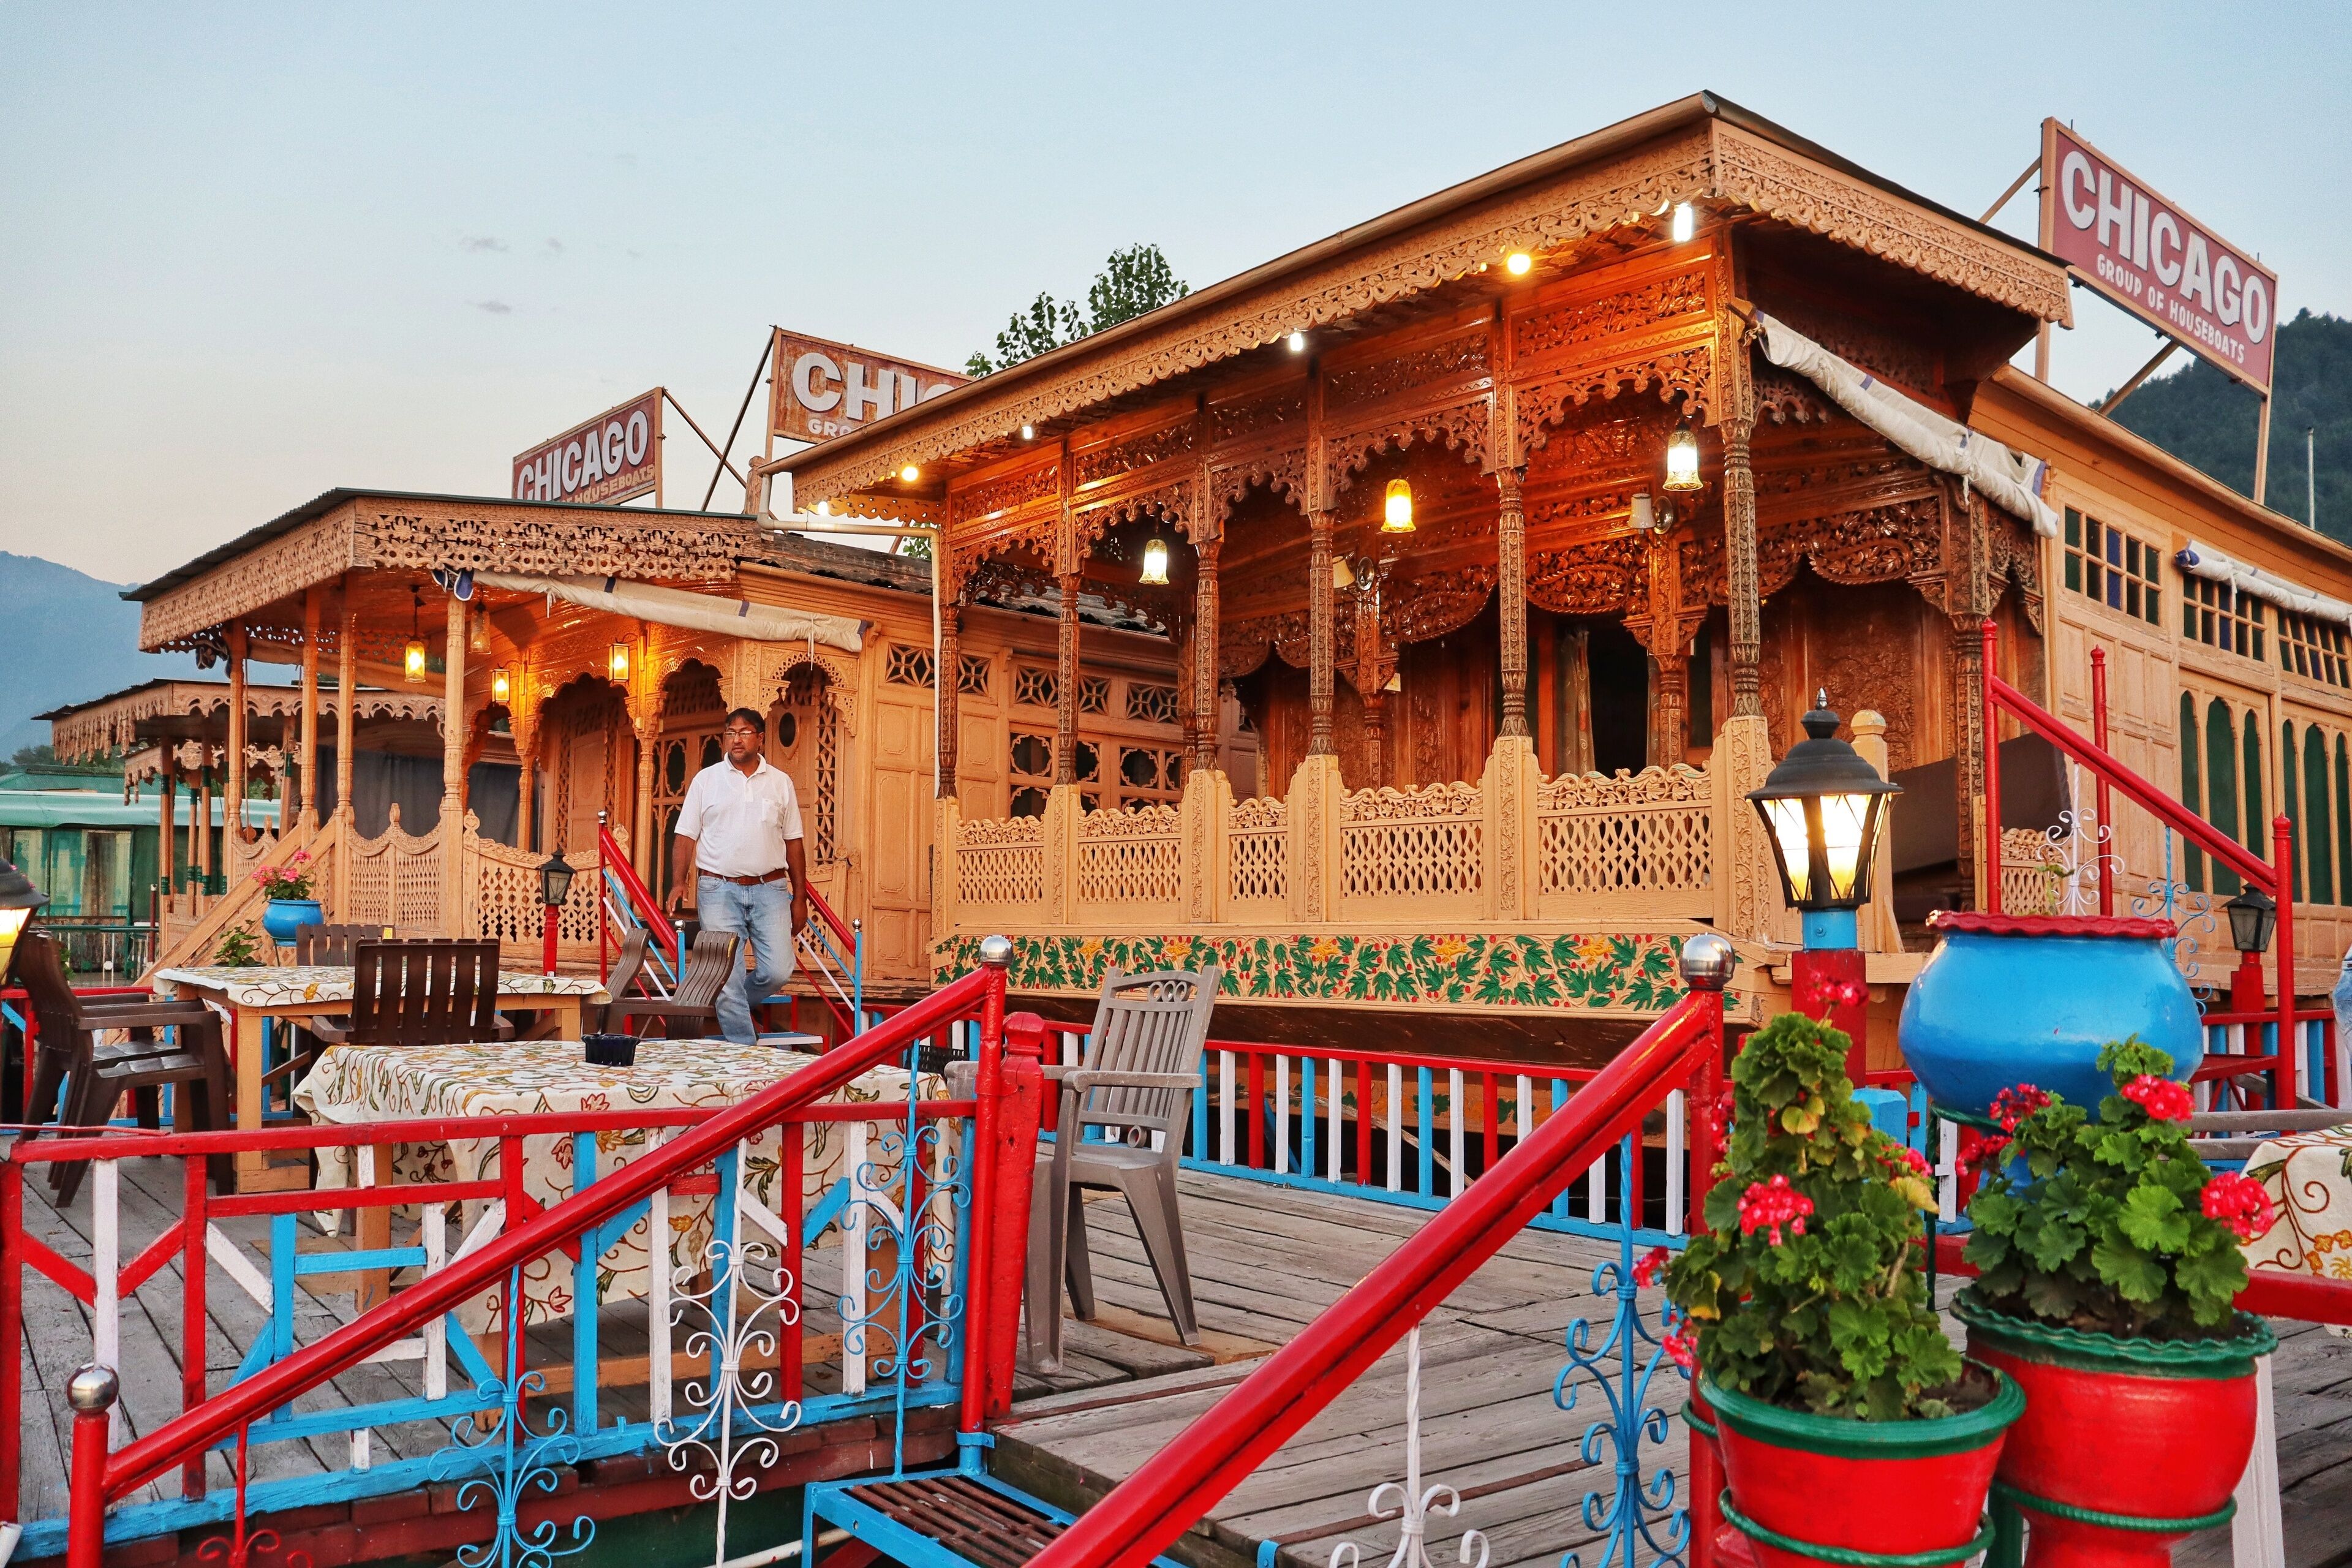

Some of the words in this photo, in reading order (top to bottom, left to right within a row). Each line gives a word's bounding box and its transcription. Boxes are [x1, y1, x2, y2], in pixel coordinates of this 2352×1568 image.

[2062, 151, 2267, 344] CHICAGO
[2097, 254, 2143, 297] GROUP
[2147, 285, 2165, 311] OF
[2169, 300, 2245, 364] HOUSEBOATS
[792, 352, 956, 421] CHI
[517, 410, 648, 501] CHICAGO
[575, 464, 655, 503] HOUSEBOATS
